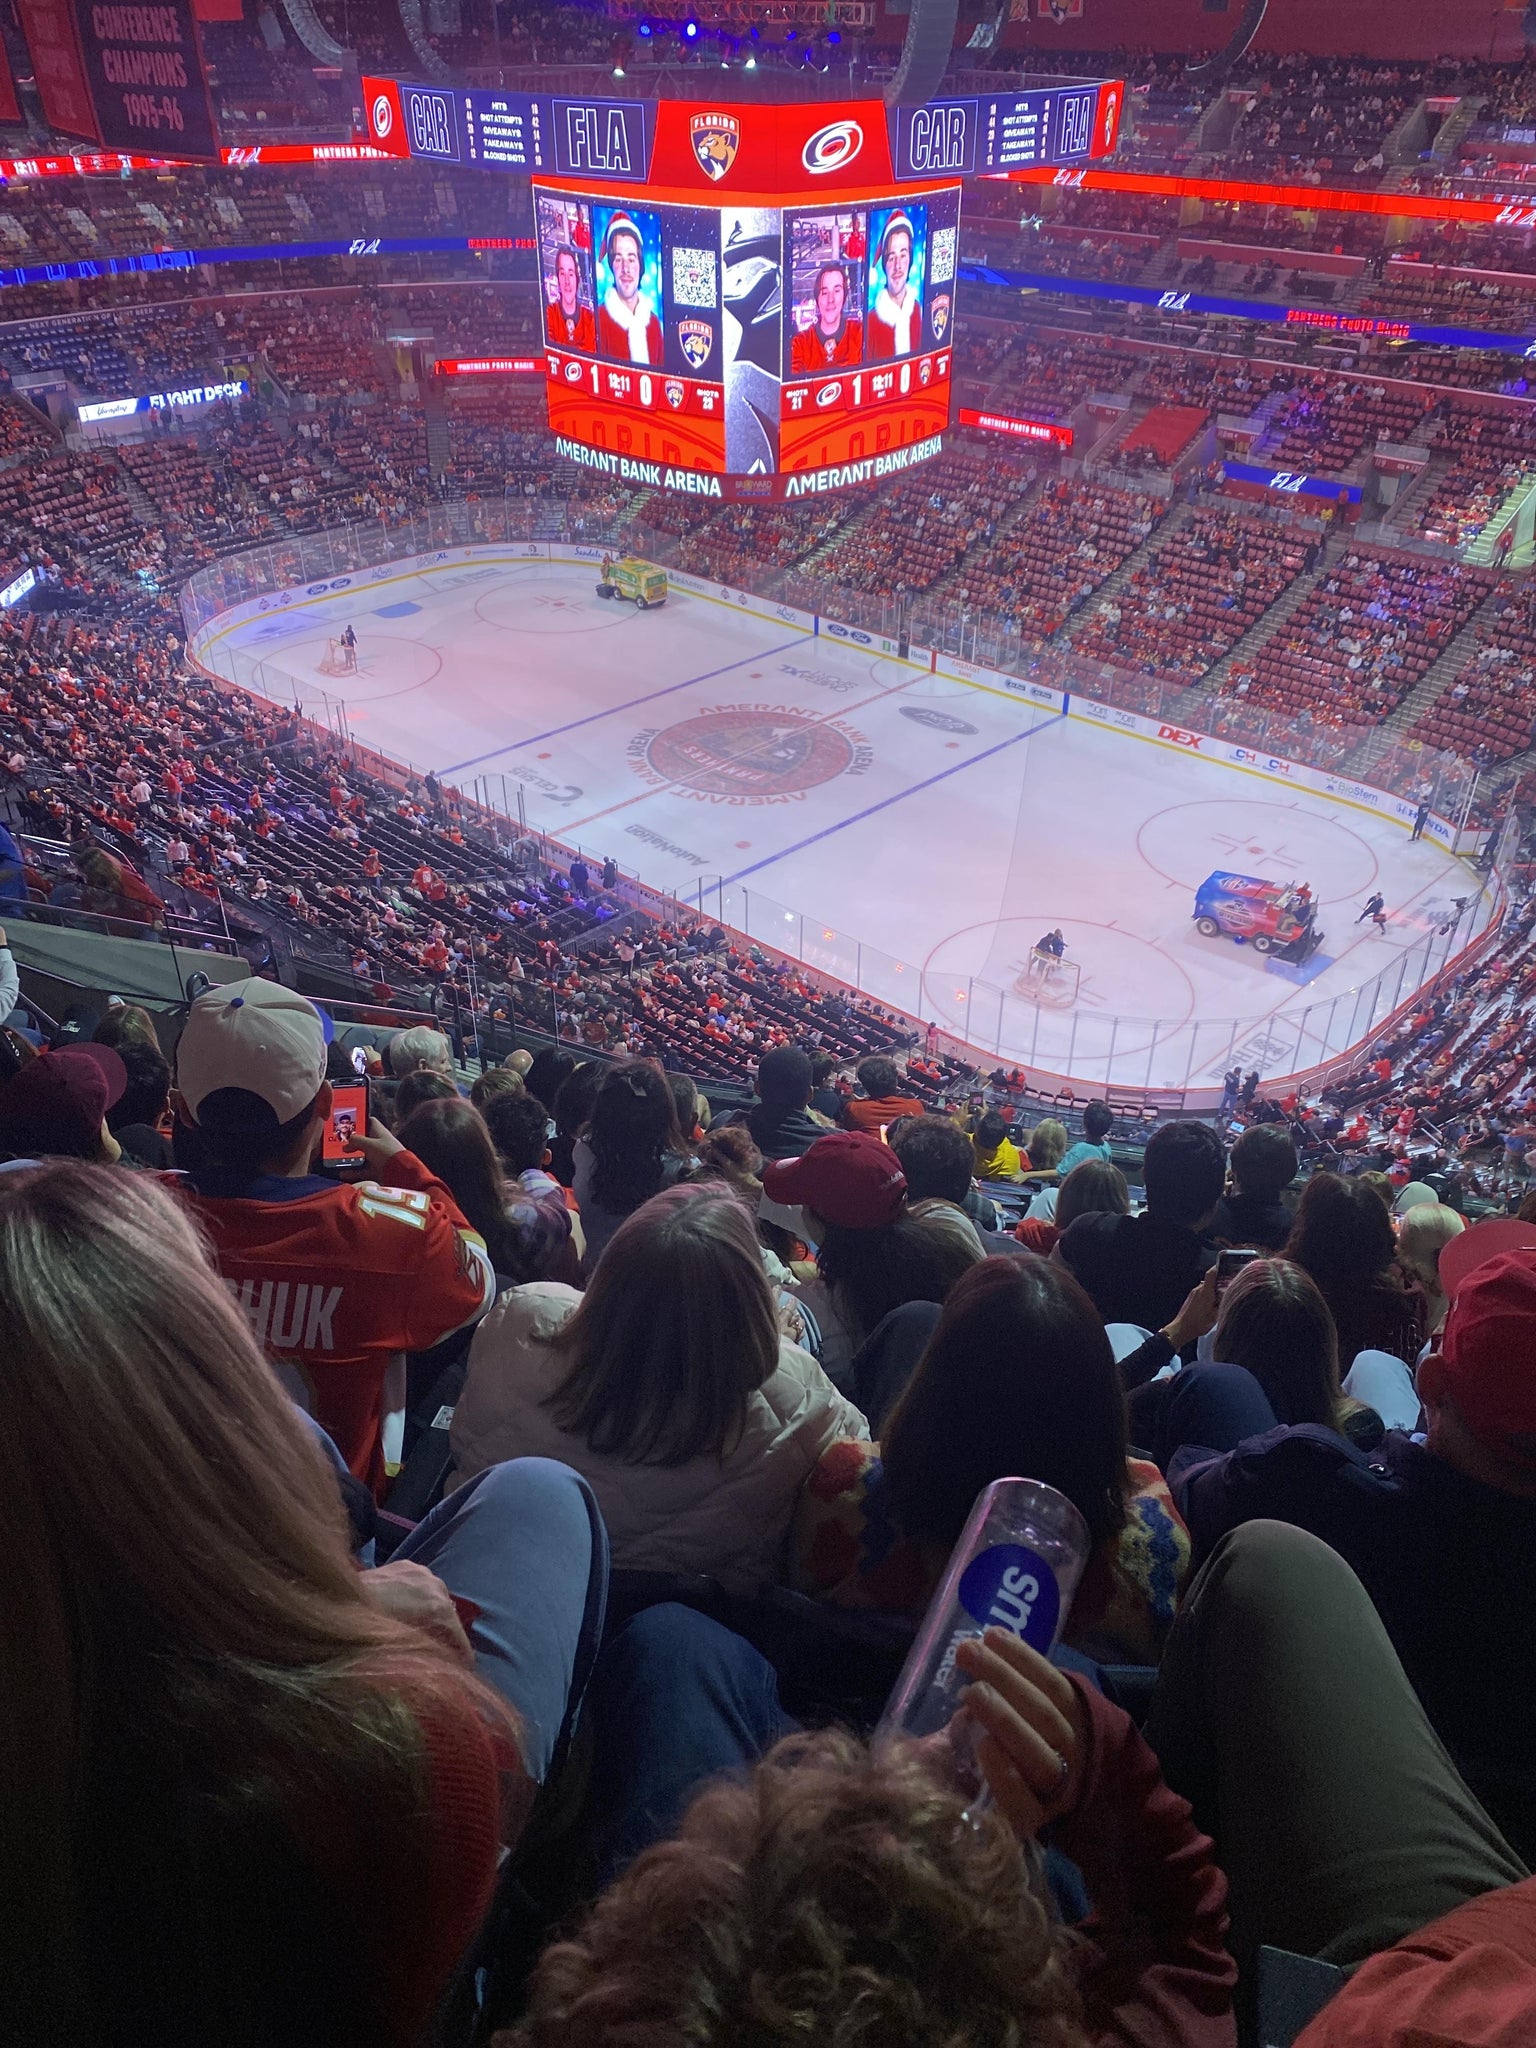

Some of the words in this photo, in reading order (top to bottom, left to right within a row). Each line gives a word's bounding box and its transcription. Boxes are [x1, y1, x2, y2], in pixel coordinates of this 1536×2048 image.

[91, 5, 183, 42] CONFERENCE
[102, 49, 188, 88] CHAMPIONS
[122, 92, 184, 131] 1995-96
[411, 94, 451, 153] CAR
[694, 115, 735, 131] FLORIDA
[566, 107, 631, 171] FLA
[1060, 97, 1091, 154] FLA
[312, 146, 358, 159] PANTHERS
[483, 138, 524, 150] TAKEAWAYS
[910, 108, 966, 171] CAR
[51, 315, 100, 328] GENERATIN
[680, 322, 712, 335] FLORIDA
[1287, 310, 1337, 329] PANTHERS
[1340, 317, 1373, 332] PHOTO
[1376, 321, 1411, 338] MAGIC
[205, 382, 243, 402] DECK
[590, 364, 599, 394] 1
[639, 374, 652, 406] 0
[696, 388, 719, 398] SHOTS
[786, 389, 808, 399] SHOTS
[852, 374, 861, 405] 1
[901, 363, 911, 394] 0
[980, 416, 1009, 429] PANTHERS
[1010, 422, 1030, 433] PHOTO
[1031, 426, 1051, 438] MAGIC
[556, 436, 618, 473] AMERANT
[620, 458, 661, 486] BANK
[664, 469, 722, 498] ARENA
[785, 460, 874, 498] AMERANT
[875, 449, 909, 477] BANK
[909, 435, 943, 466] ARENA
[829, 624, 847, 636] Ford
[852, 632, 871, 643] Ford
[910, 650, 929, 662] Health
[626, 727, 660, 758] ARENA
[831, 719, 870, 743] BANK
[1158, 725, 1204, 750] DEX
[844, 745, 874, 776] ARENA
[1236, 749, 1256, 762] CH
[1269, 759, 1290, 773] CH
[627, 758, 665, 785] BANK
[1407, 808, 1449, 838] HNDA
